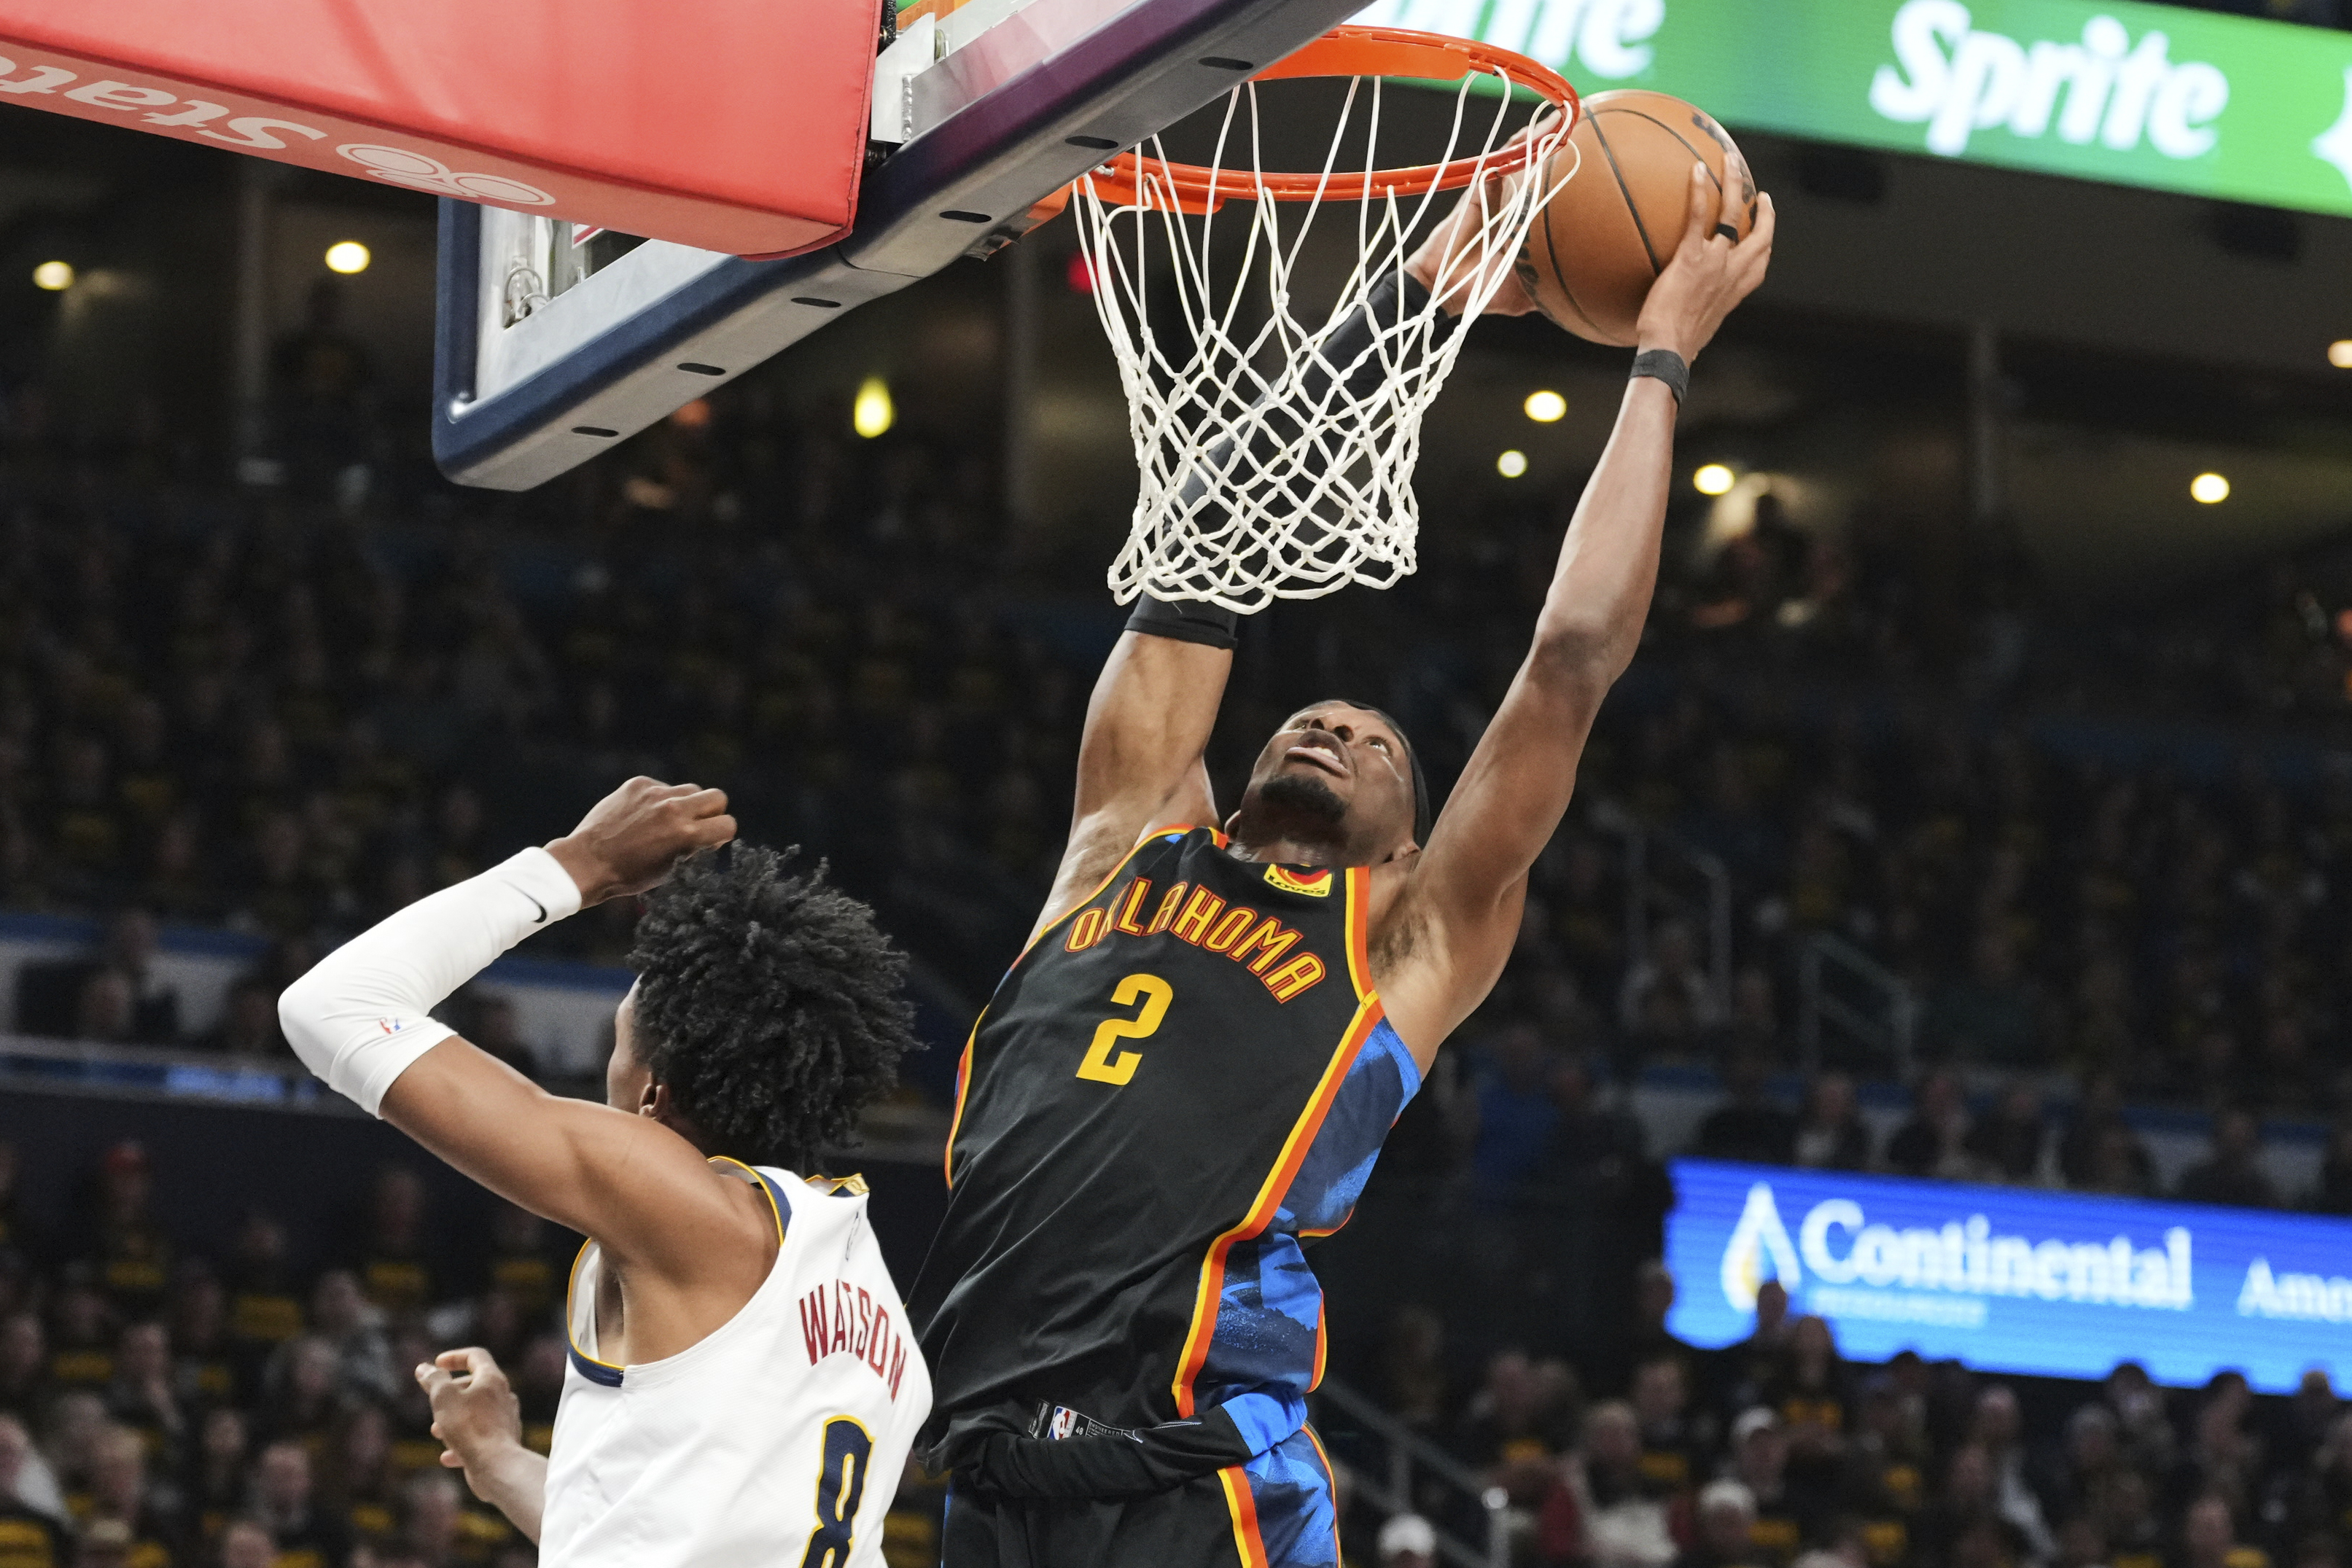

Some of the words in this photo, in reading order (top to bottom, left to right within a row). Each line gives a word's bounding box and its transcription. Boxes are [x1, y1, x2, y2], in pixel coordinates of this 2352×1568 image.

[0, 56, 328, 149] Stat
[1869, 0, 2230, 159] Sprite
[1075, 973, 1173, 1085] 2
[1800, 1198, 2193, 1312] Continental
[799, 1279, 906, 1404] WATSON
[799, 1414, 876, 1568] 8
